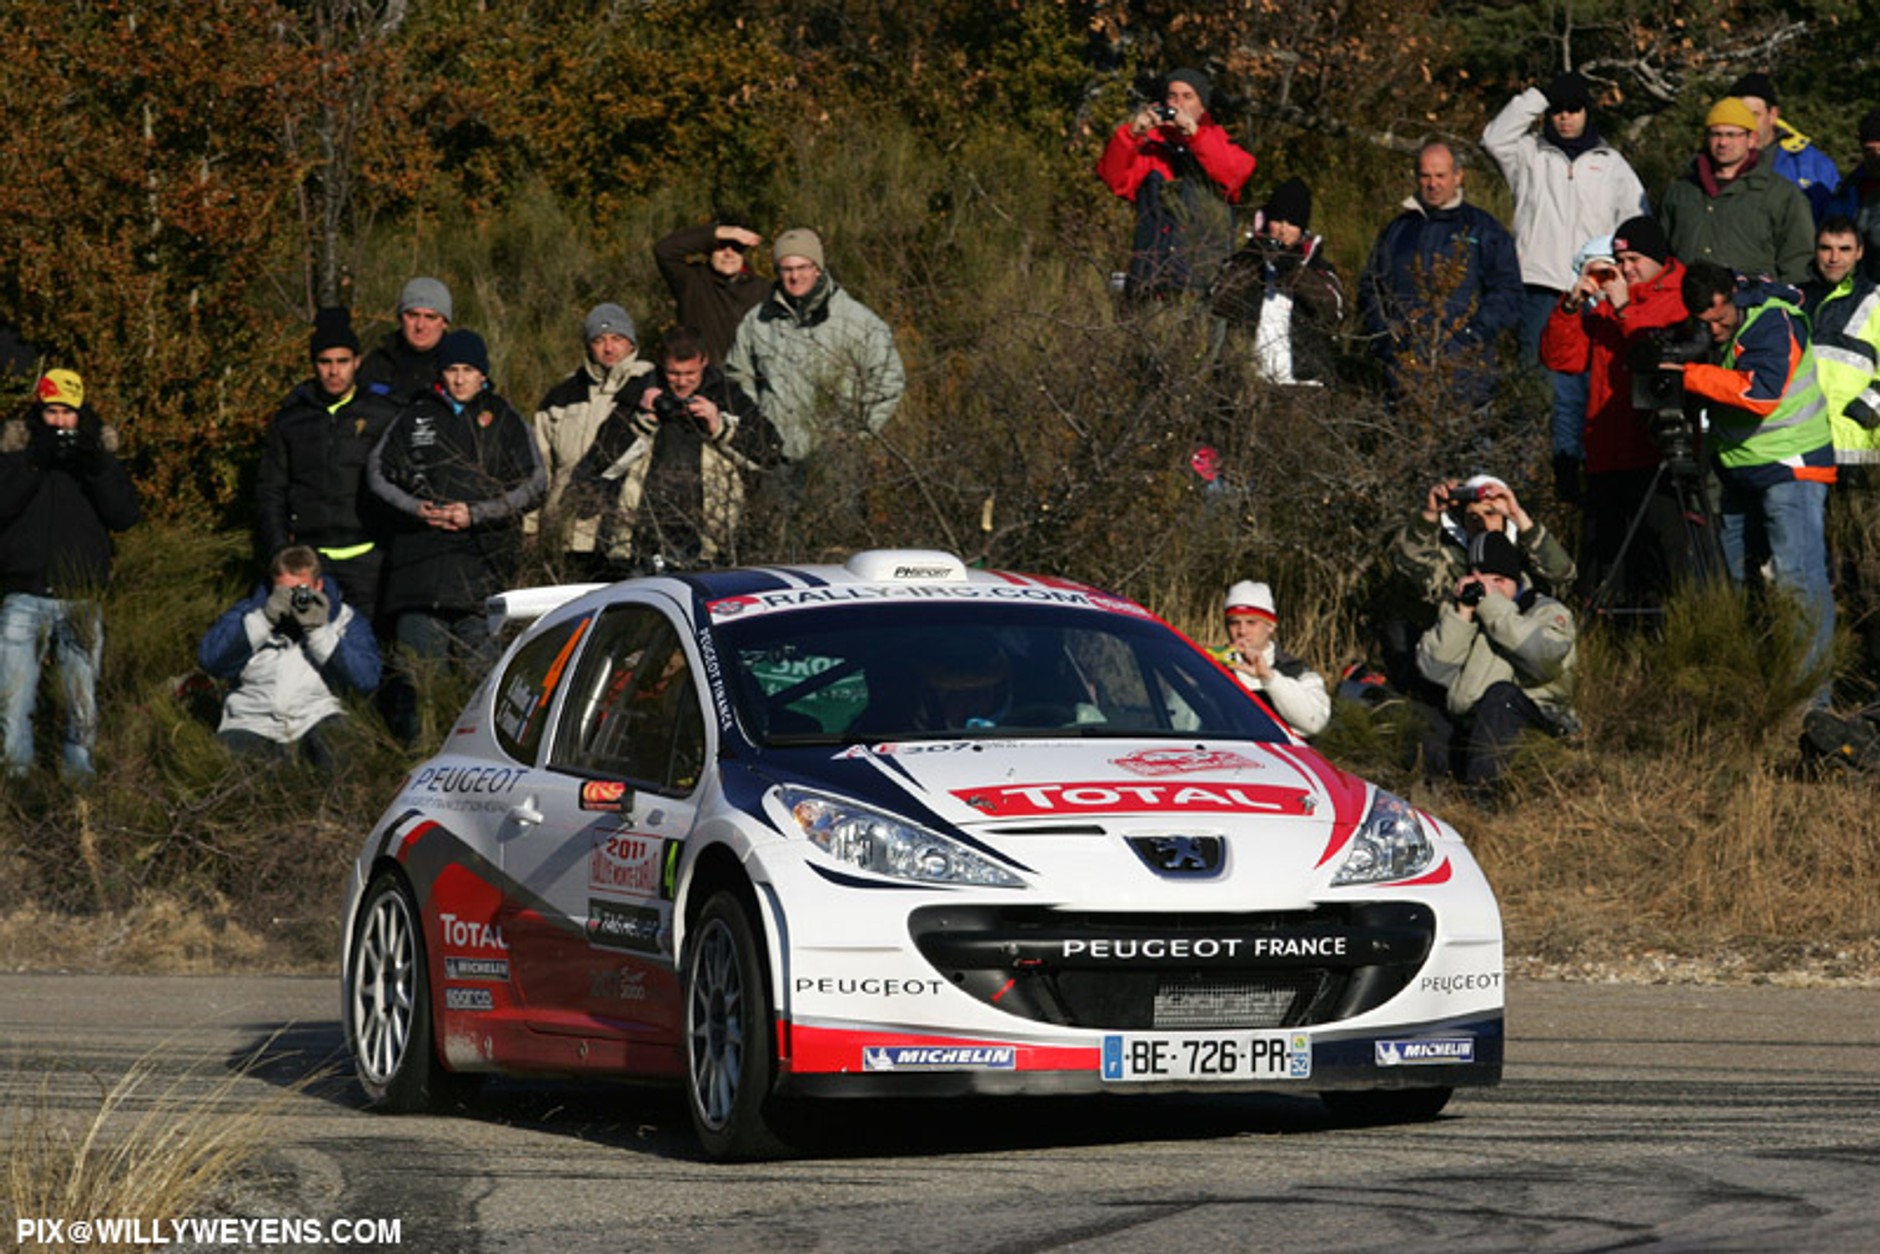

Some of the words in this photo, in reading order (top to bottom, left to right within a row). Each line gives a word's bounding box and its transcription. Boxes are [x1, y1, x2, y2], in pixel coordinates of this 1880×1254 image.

[700, 627, 720, 678] PEUGEOT
[411, 766, 530, 794] PEUGEOT
[1002, 785, 1283, 810] TOTAL
[606, 838, 647, 861] 2011
[1063, 939, 1242, 958] PEUGEOT
[1254, 937, 1346, 956] FRANCE
[795, 978, 944, 996] PEUGEOT
[1421, 973, 1501, 993] PEUGEOT
[897, 1048, 1011, 1063] MICHELIN
[1403, 1042, 1473, 1058] MICHELIN
